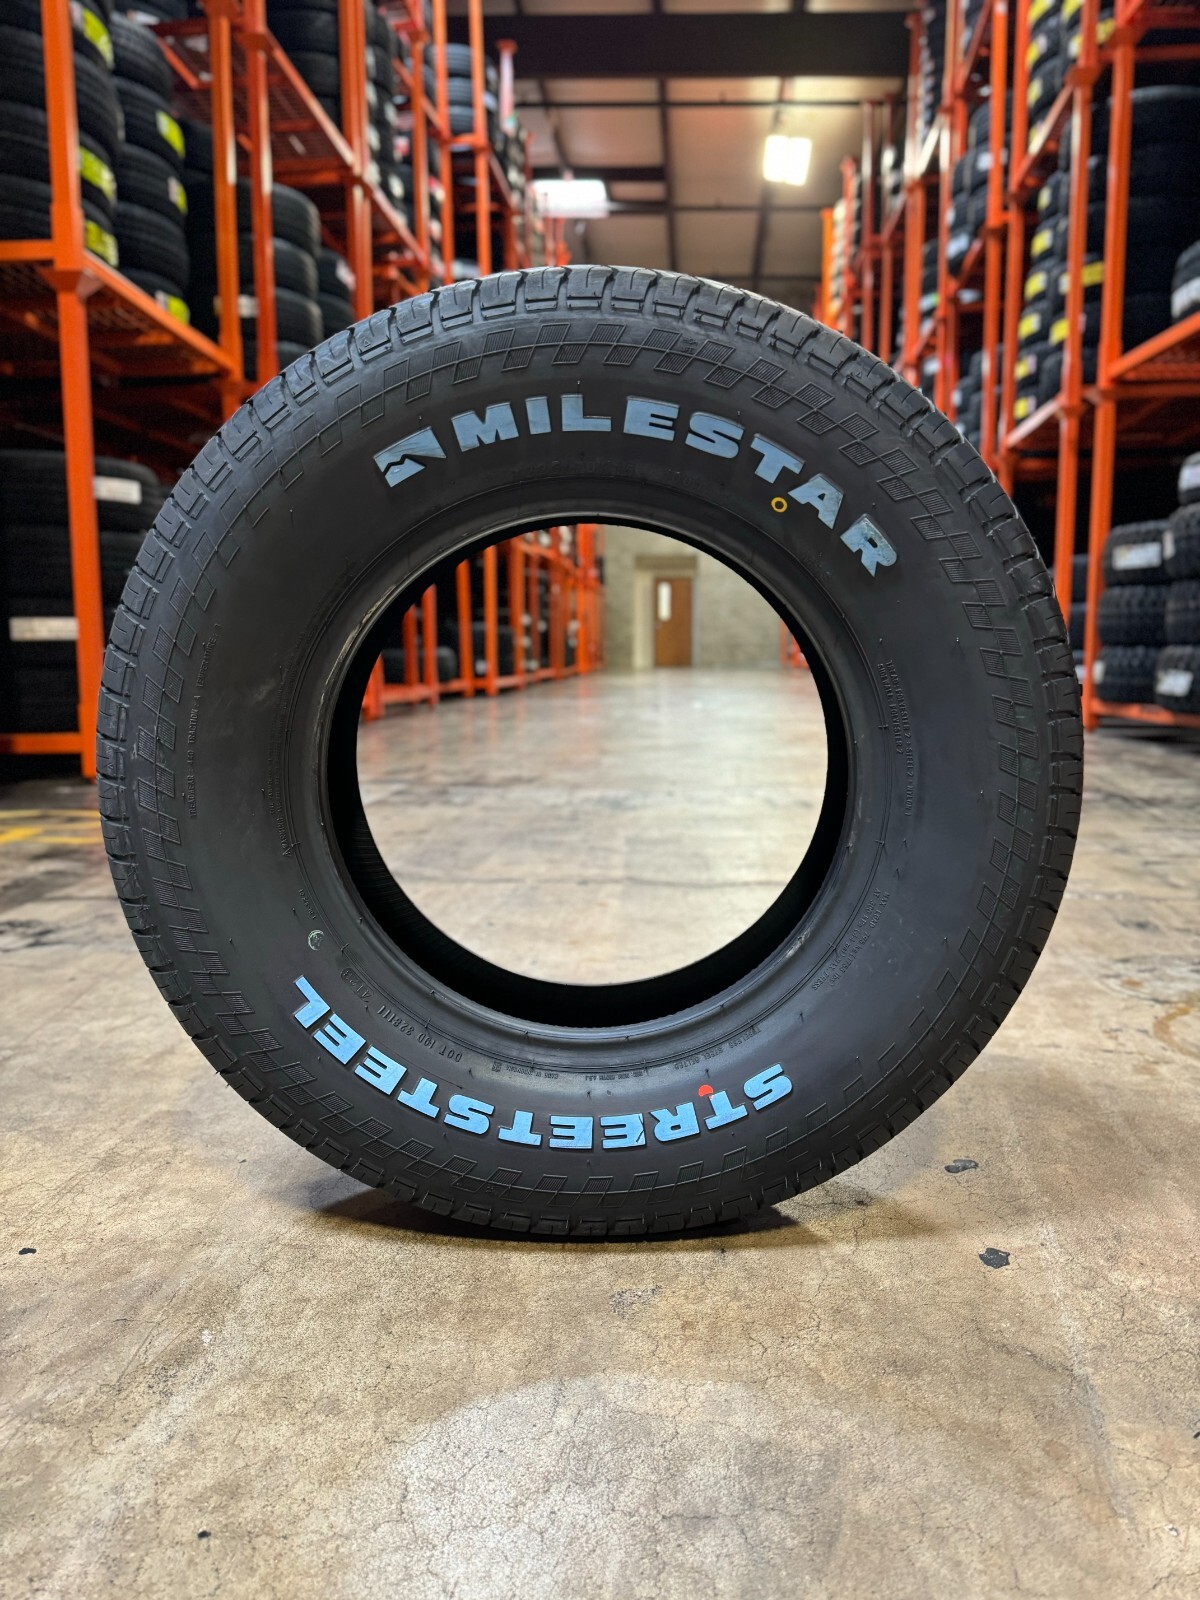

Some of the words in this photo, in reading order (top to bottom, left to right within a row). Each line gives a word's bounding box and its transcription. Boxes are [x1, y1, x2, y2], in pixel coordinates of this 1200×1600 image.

[452, 394, 898, 577] MILESTAR
[293, 975, 793, 1149] STREETSTEEL
[439, 1045, 462, 1062] DOT
